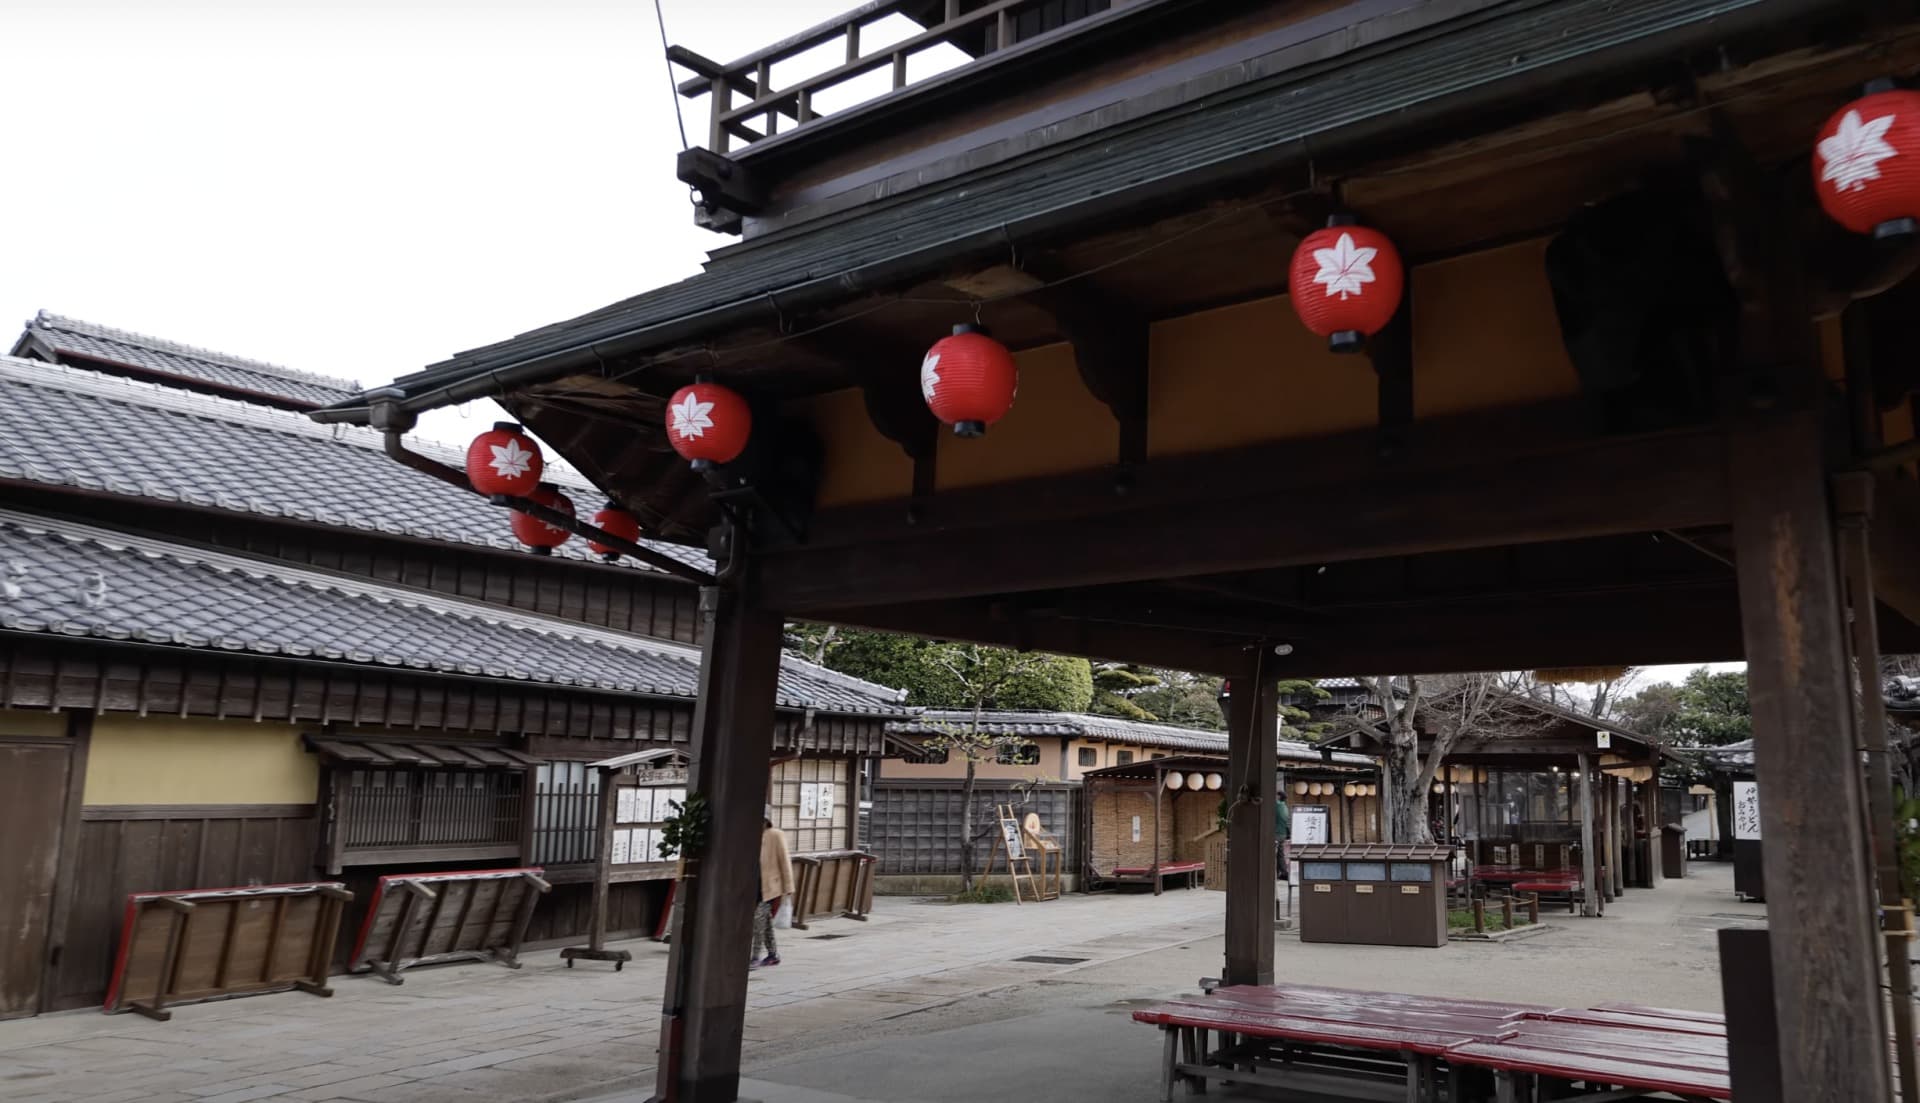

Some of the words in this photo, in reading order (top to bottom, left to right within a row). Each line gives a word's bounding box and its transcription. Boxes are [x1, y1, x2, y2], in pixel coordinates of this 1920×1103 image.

[1737, 800, 1747, 831] おみやげ
[1745, 787, 1759, 833] 伊勢うどん
